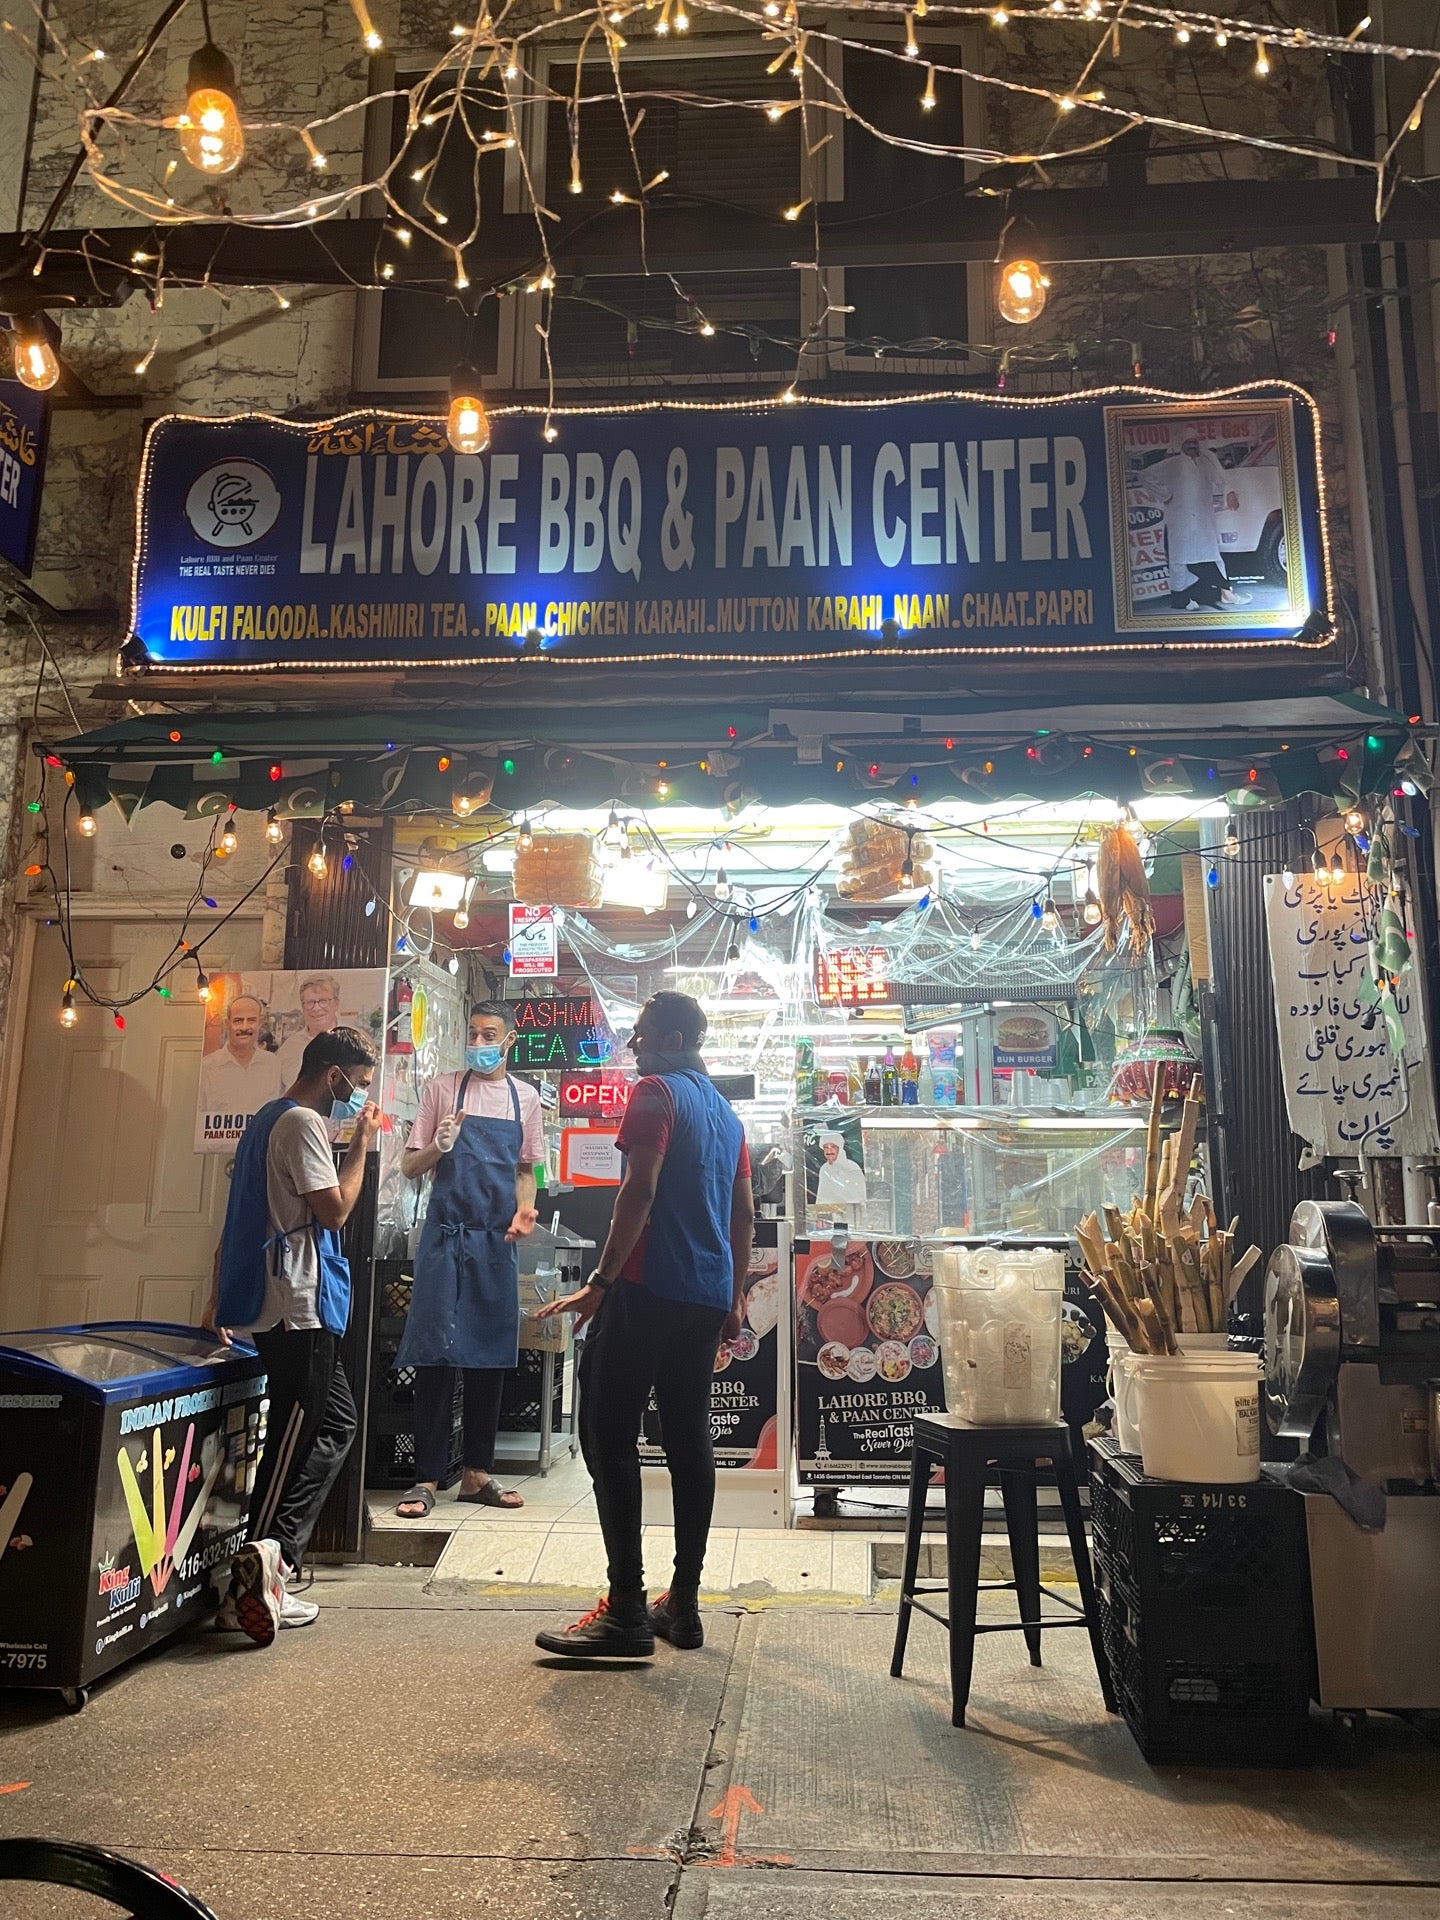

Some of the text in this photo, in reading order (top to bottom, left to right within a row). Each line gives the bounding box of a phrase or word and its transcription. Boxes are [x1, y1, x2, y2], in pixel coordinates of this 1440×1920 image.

[299, 435, 1094, 583] LAHORE BBQ & PAAN CENTER
[179, 564, 276, 577] THE REAL TASTE NEVER DIES
[170, 605, 228, 641] KULFI
[329, 603, 425, 639] KASHMIRI
[545, 600, 629, 637] CHICKEN
[716, 596, 800, 633] MUTTON
[1035, 589, 1094, 626] PAPRI
[525, 908, 541, 917] NO
[516, 1033, 567, 1062] TEA
[996, 1055, 1053, 1063] BUN BURGER
[566, 1084, 629, 1105] OPEN
[203, 1130, 225, 1140] PAAN
[710, 1380, 746, 1396] BBQ
[647, 1399, 658, 1411] &
[818, 1389, 928, 1410] LAHORE BBQ
[119, 1398, 174, 1436] INDIAN
[829, 1411, 840, 1424] &
[842, 1407, 880, 1423] PAAN
[865, 1428, 889, 1439] Real
[860, 1438, 891, 1452] Never
[98, 1564, 131, 1596] King
[109, 1575, 142, 1612] Kulfi
